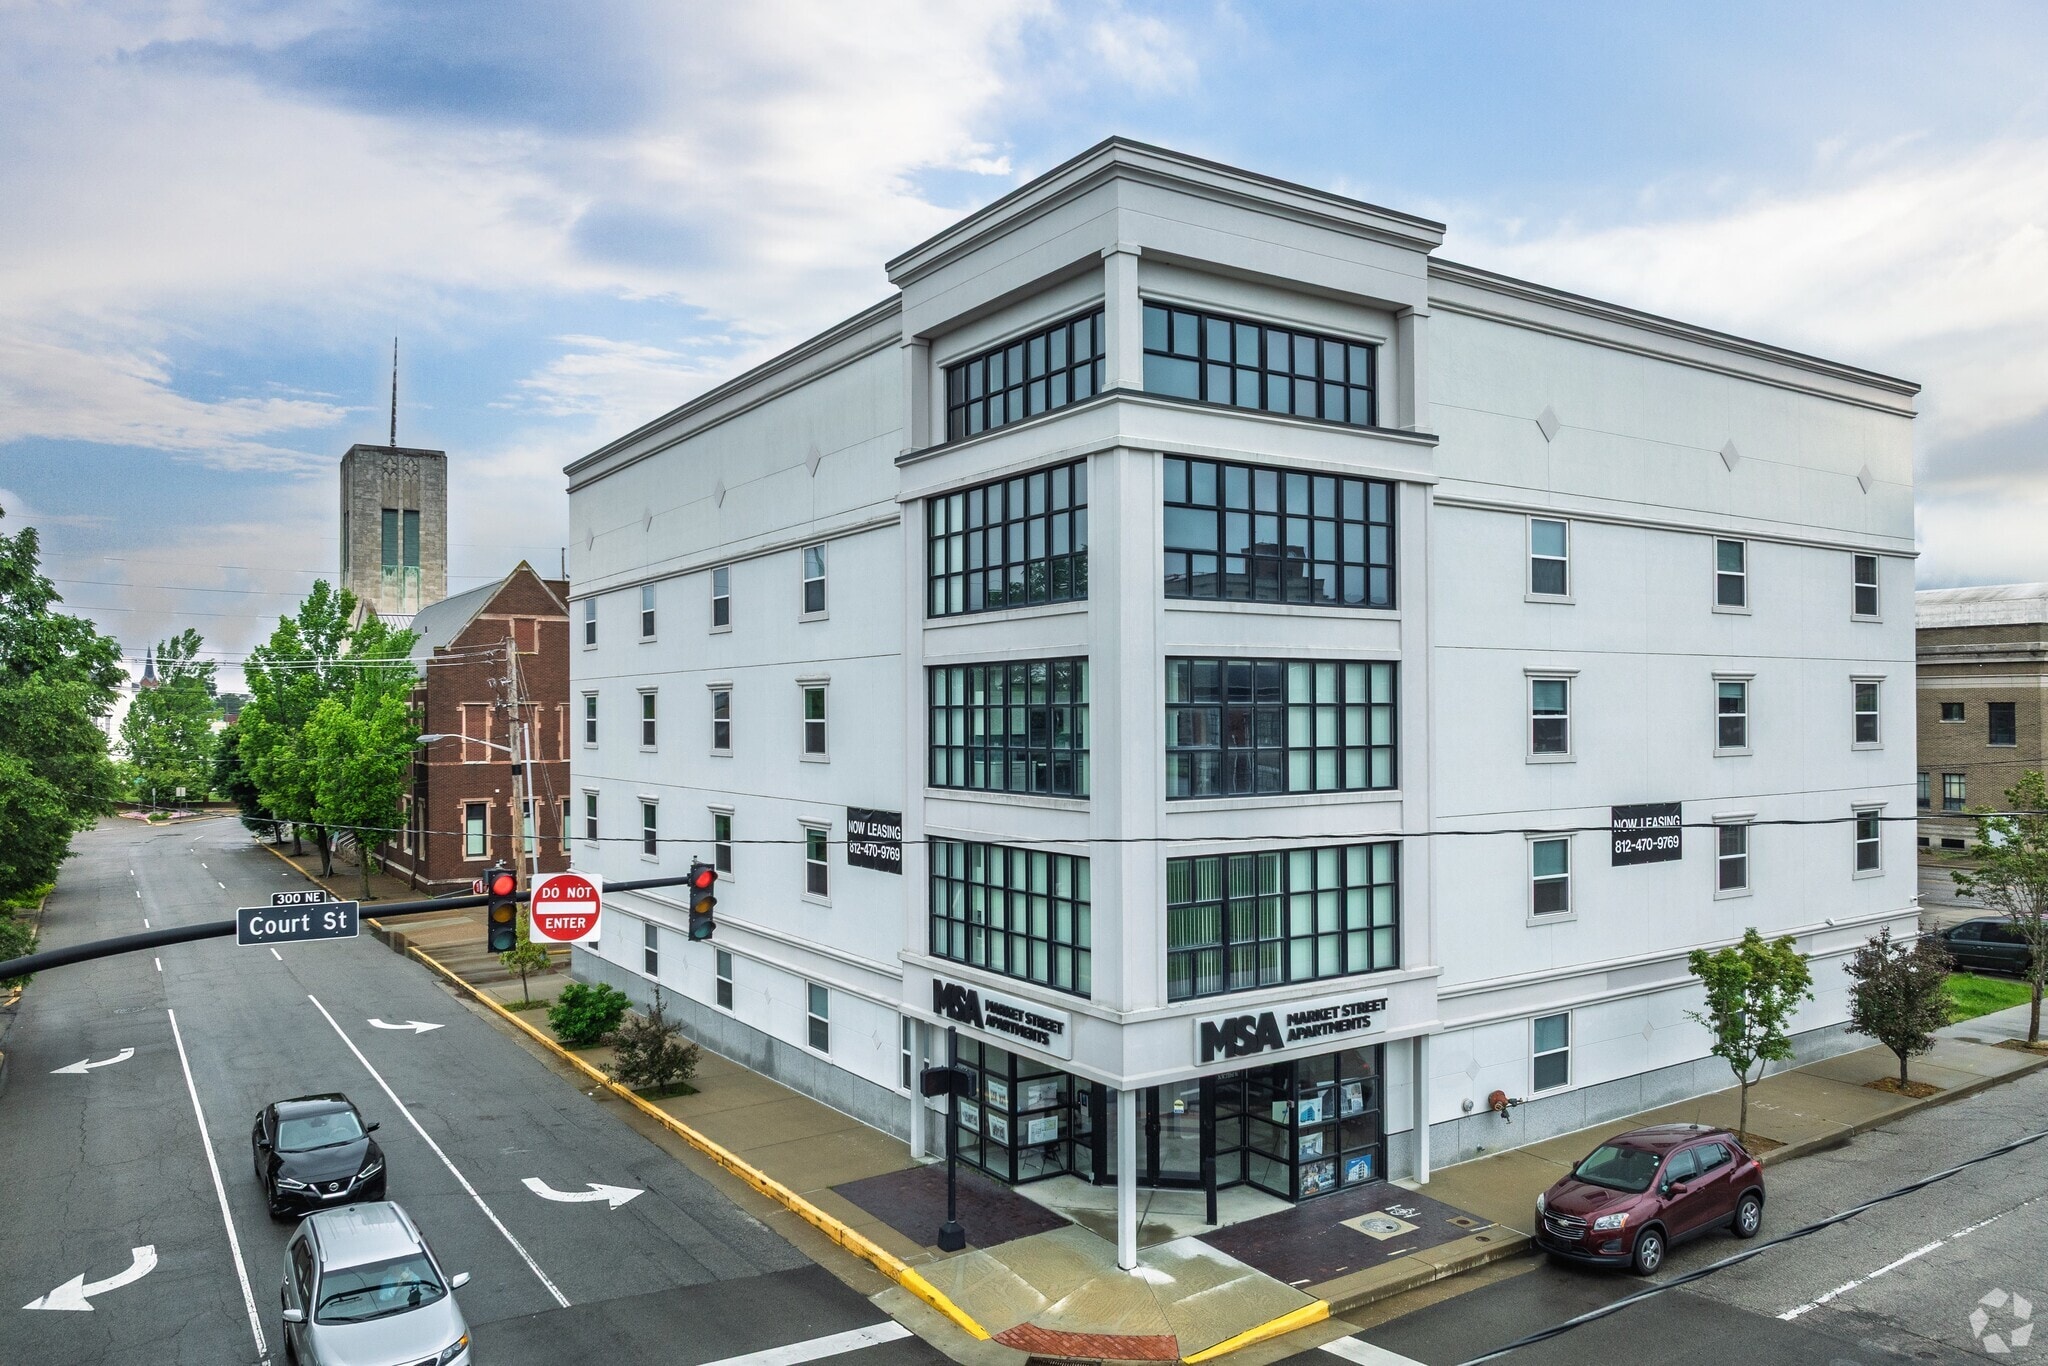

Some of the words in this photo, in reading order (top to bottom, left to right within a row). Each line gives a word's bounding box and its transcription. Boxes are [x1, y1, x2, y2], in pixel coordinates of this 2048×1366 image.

[848, 819, 865, 835] NOW
[867, 822, 901, 840] LEASING
[1613, 818, 1638, 833] NOW
[849, 842, 900, 862] 812-470-9769
[1615, 835, 1679, 854] 812-470-9769
[277, 893, 300, 904] 300
[305, 892, 321, 903] NE
[542, 887, 560, 899] DO
[566, 886, 592, 899] NOT
[249, 913, 310, 935] Court
[323, 911, 347, 930] St
[545, 917, 586, 929] ENTER
[933, 978, 985, 1030] MSA
[1286, 1005, 1341, 1027] MARKET
[1341, 998, 1388, 1017] STREET
[985, 999, 1025, 1023] MARKET
[1025, 1012, 1065, 1035] STREET
[985, 1014, 1050, 1045] APARTMENTS
[1200, 1011, 1285, 1063] MSA
[1286, 1015, 1371, 1042] APARTMENTS
